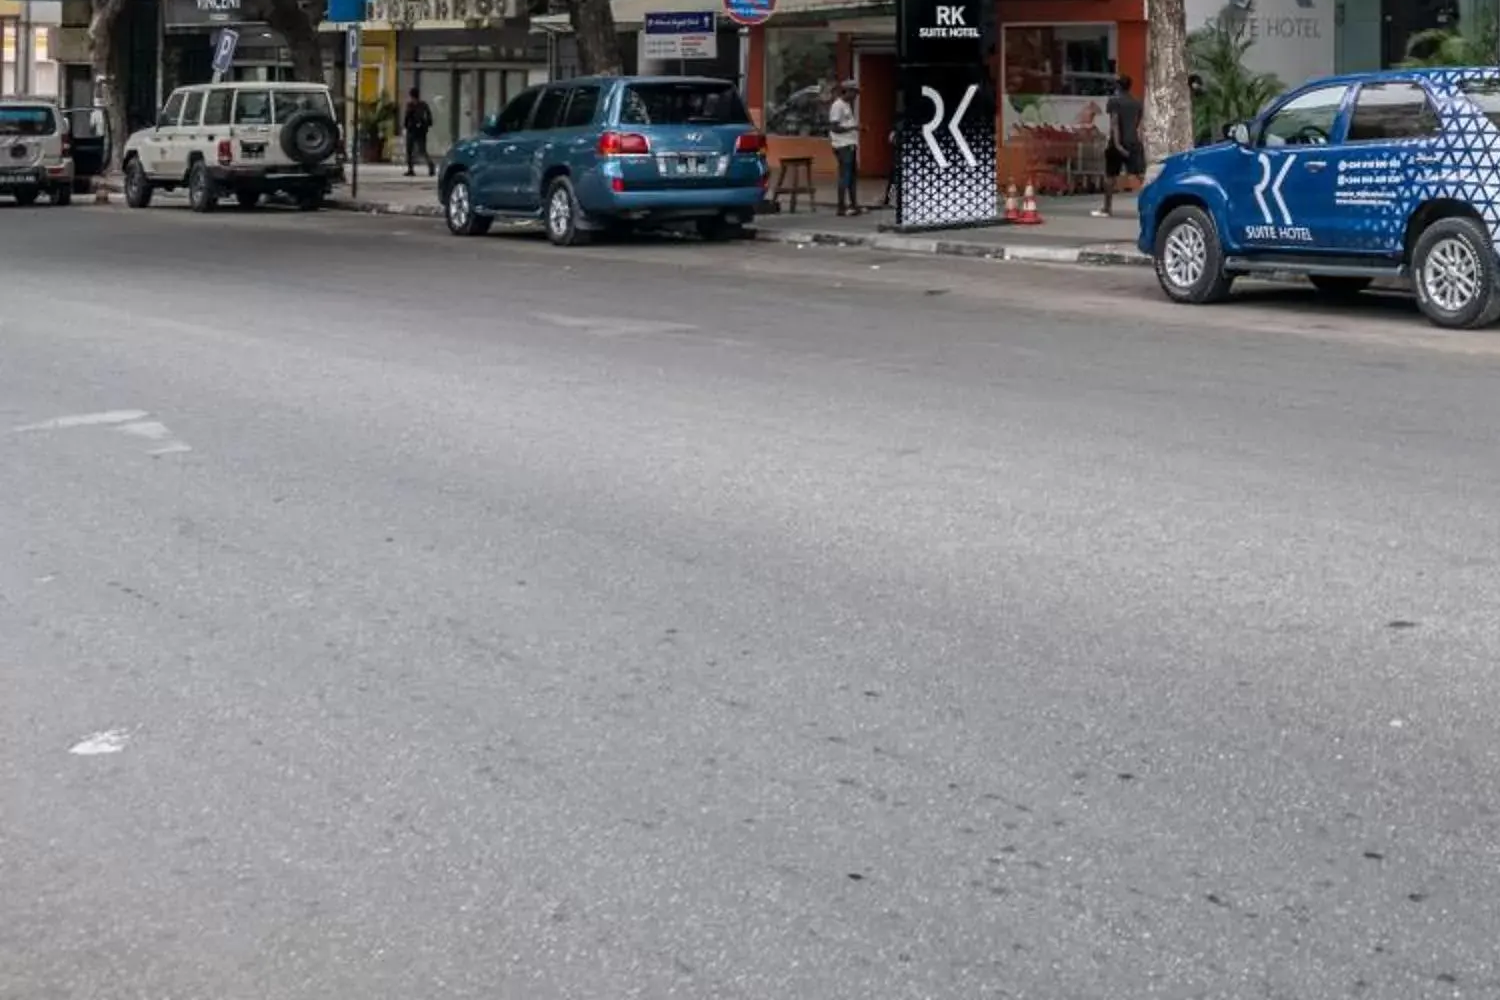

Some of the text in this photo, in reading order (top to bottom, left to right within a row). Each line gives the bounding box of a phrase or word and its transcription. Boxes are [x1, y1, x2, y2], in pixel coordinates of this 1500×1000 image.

[936, 5, 966, 26] RK
[919, 27, 981, 38] SUITE HOTEL
[1266, 18, 1322, 39] HOTEL
[217, 36, 231, 64] P
[1245, 225, 1314, 241] SUITE HOTEL
